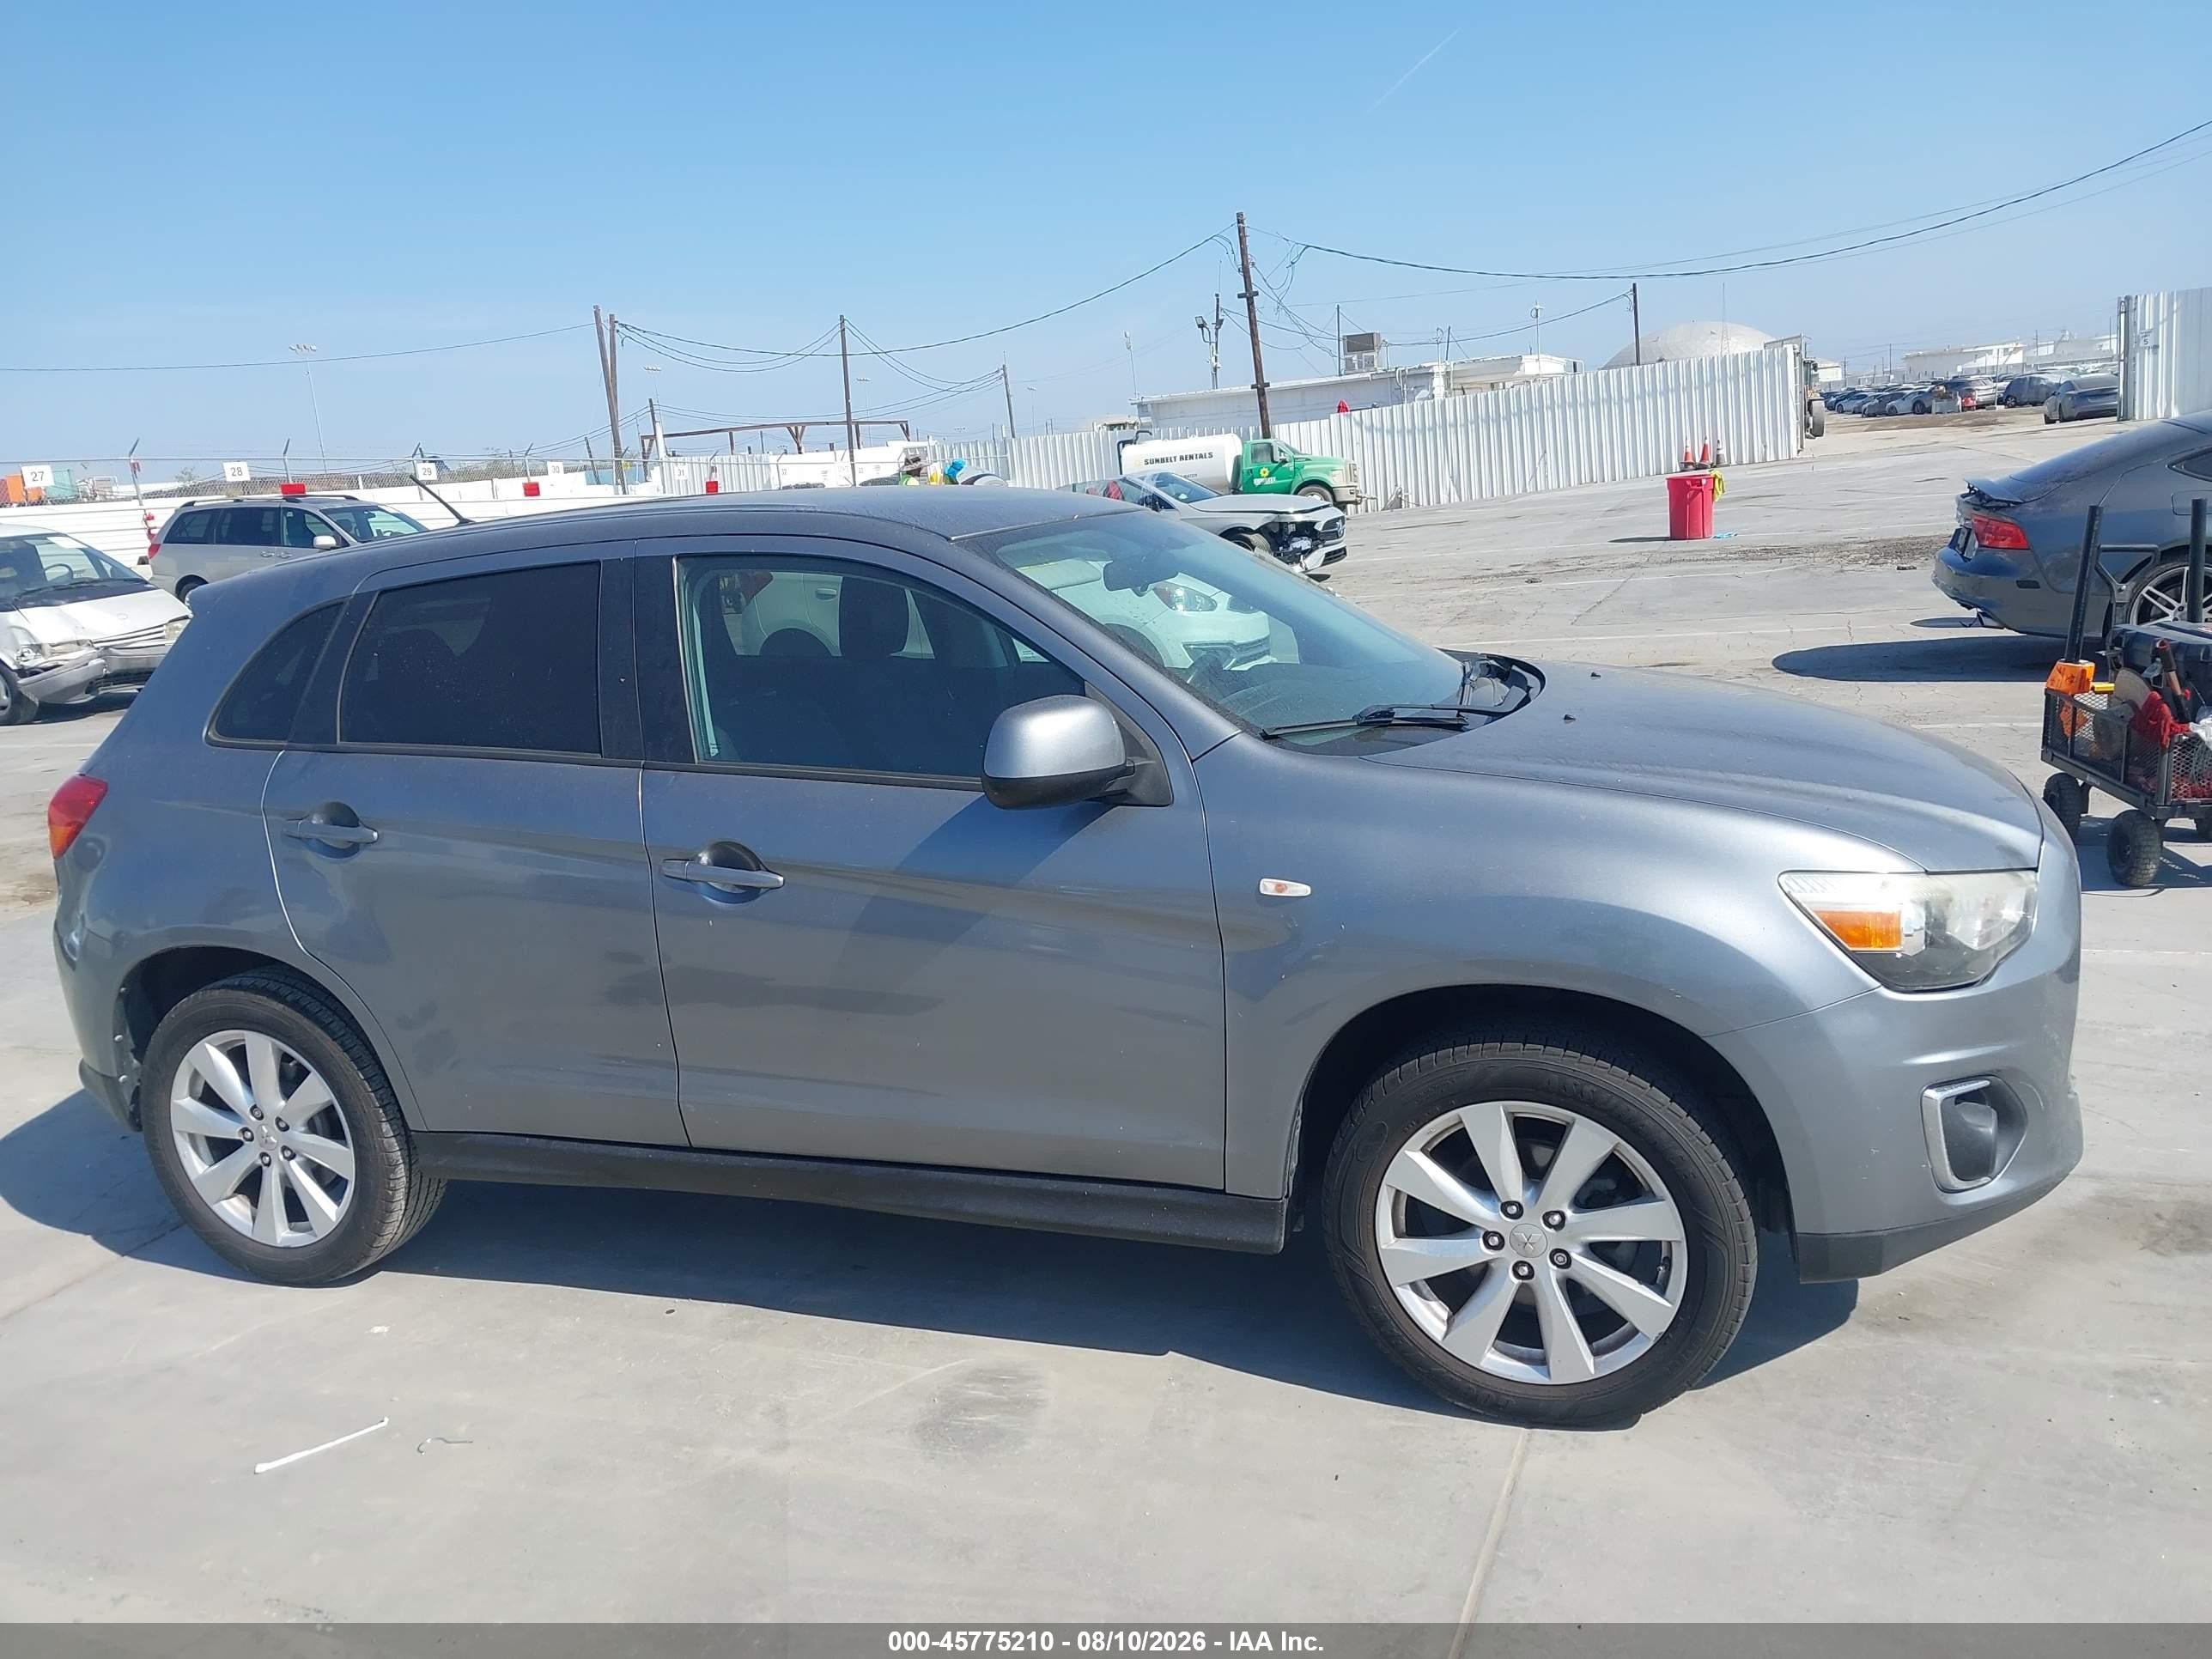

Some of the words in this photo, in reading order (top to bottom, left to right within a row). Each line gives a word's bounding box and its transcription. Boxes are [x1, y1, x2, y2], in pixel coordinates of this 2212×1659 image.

[1144, 455, 1177, 465] SUNBELT
[1179, 452, 1214, 462] RENTALS
[231, 466, 243, 477] 28
[422, 467, 432, 476] 29
[551, 465, 560, 474] 30
[678, 468, 685, 477] 31
[30, 471, 45, 482] 27
